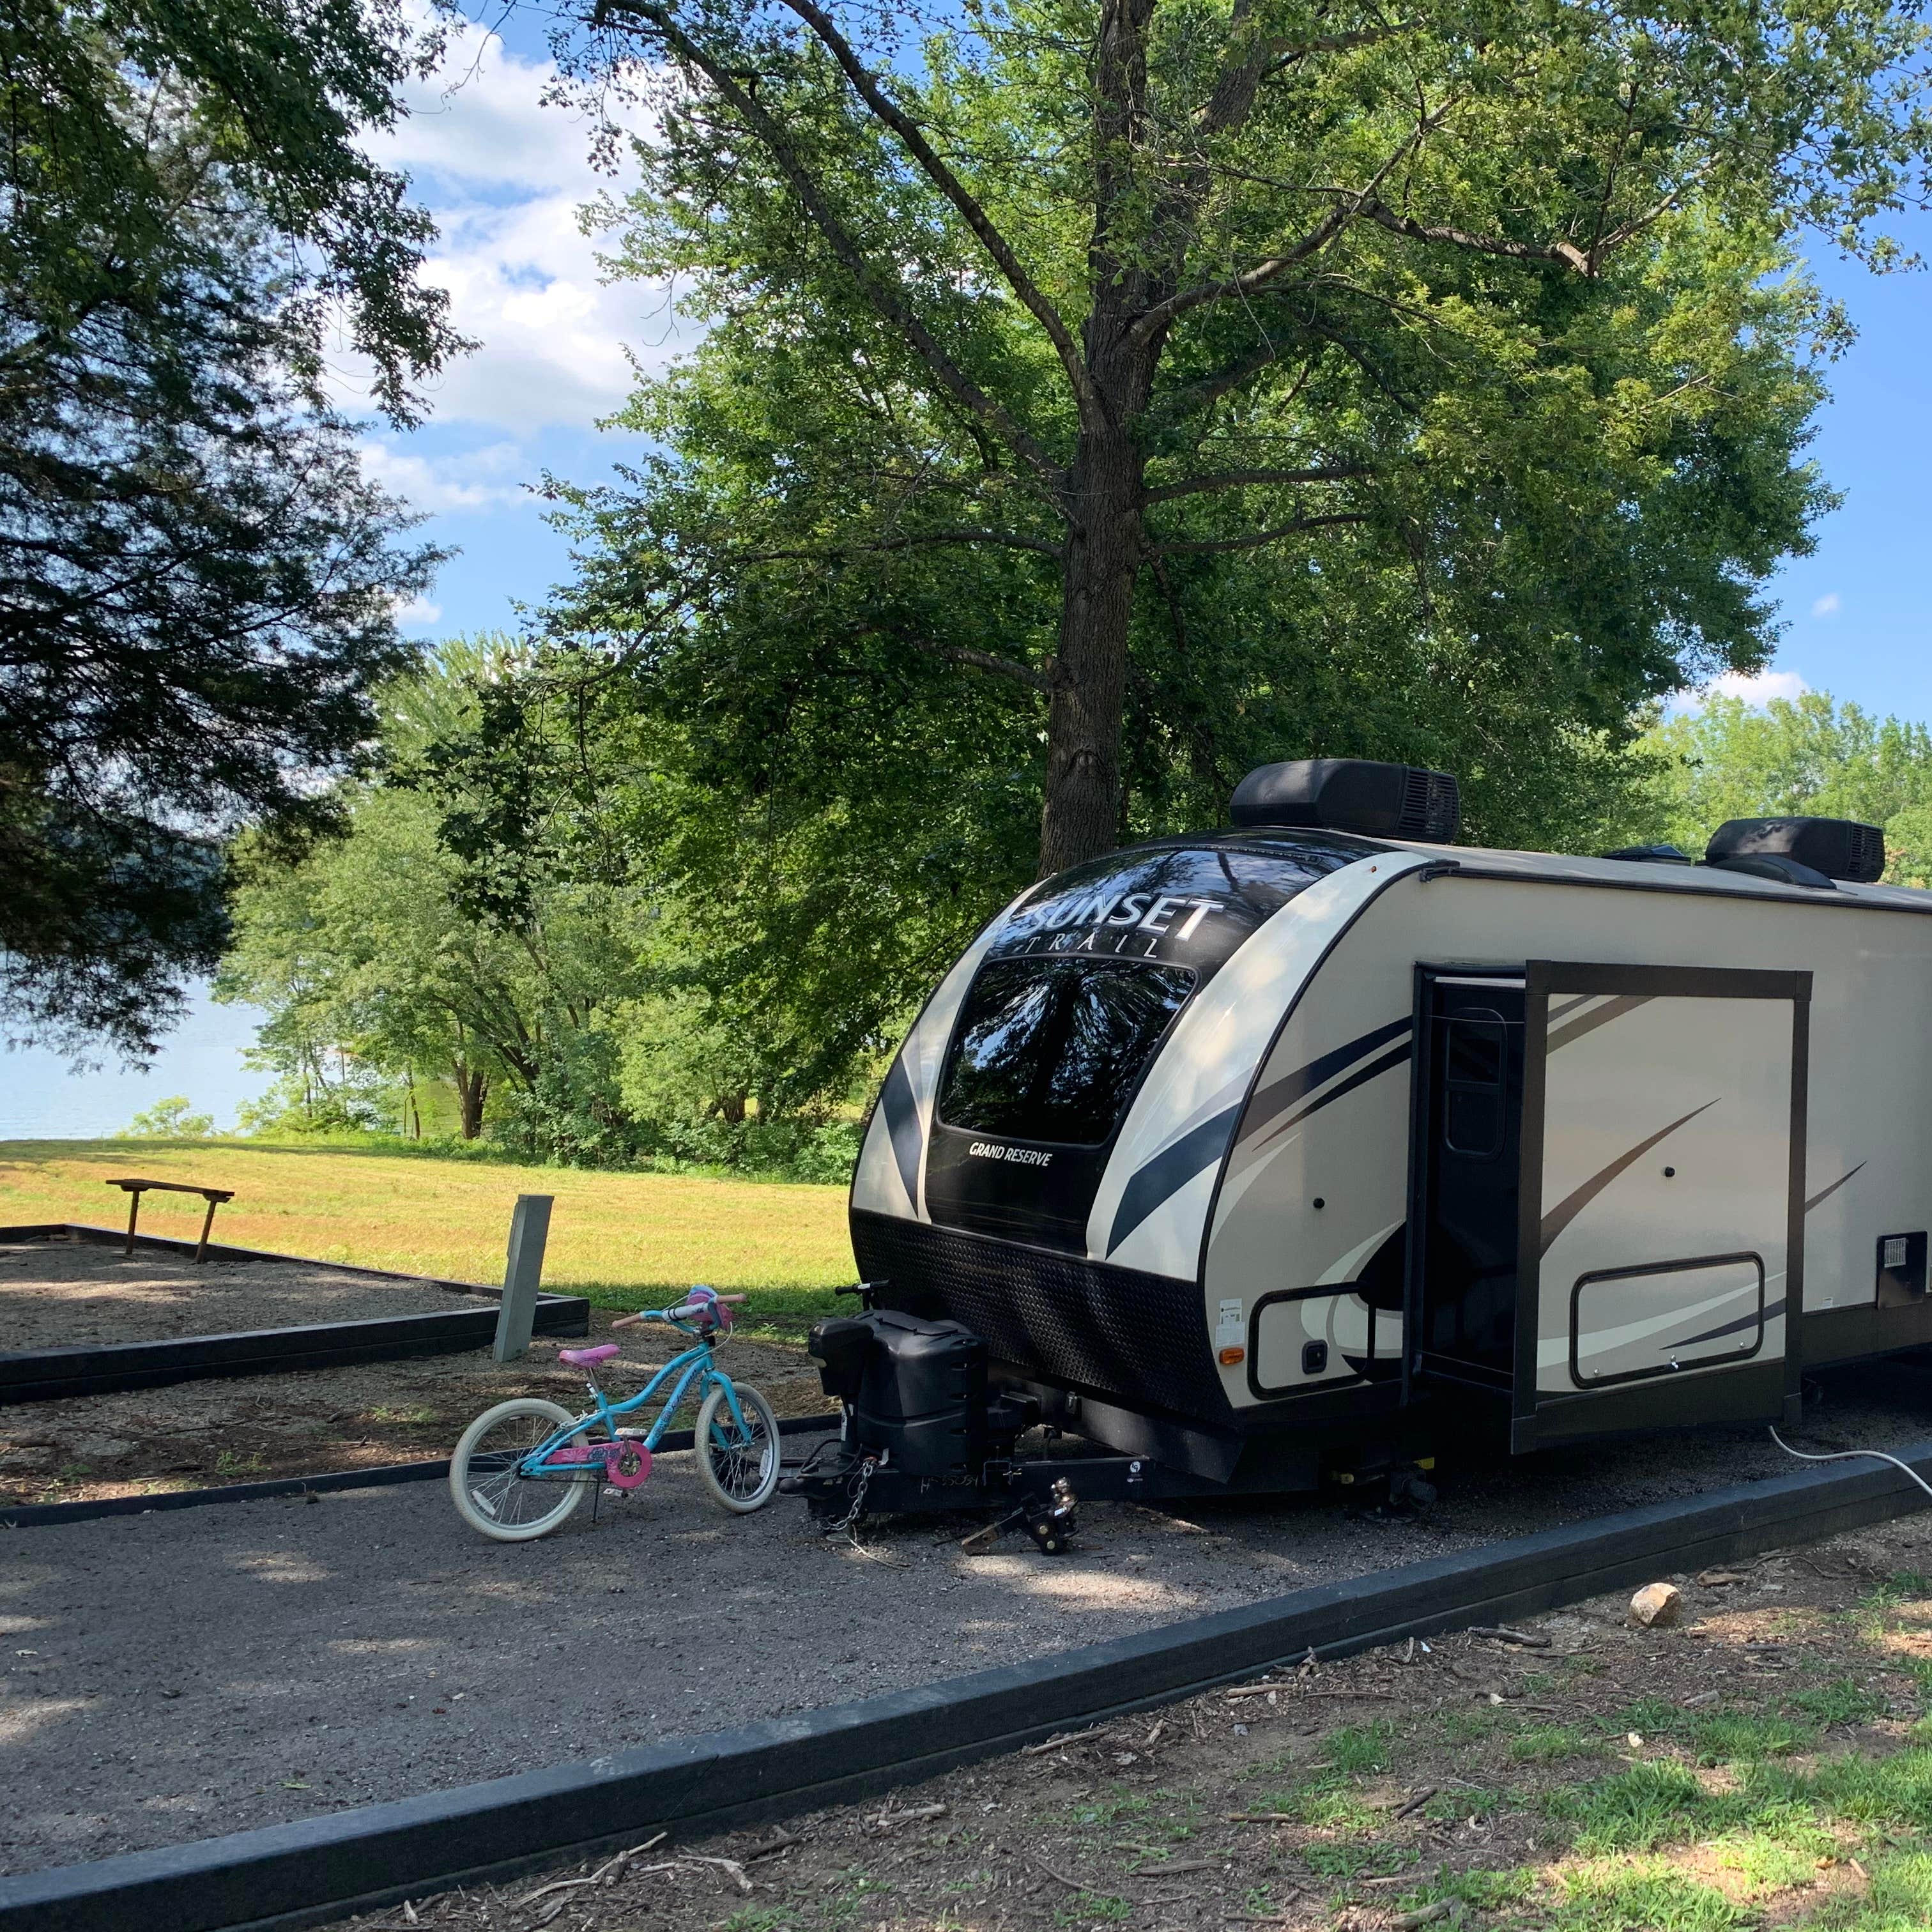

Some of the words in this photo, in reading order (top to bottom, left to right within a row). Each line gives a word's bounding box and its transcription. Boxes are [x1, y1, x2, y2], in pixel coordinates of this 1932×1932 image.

[1022, 893, 1226, 942] SUNSET
[1024, 932, 1158, 958] TRAIL
[969, 1142, 1005, 1159] GRAND
[1004, 1147, 1053, 1167] RESERVE
